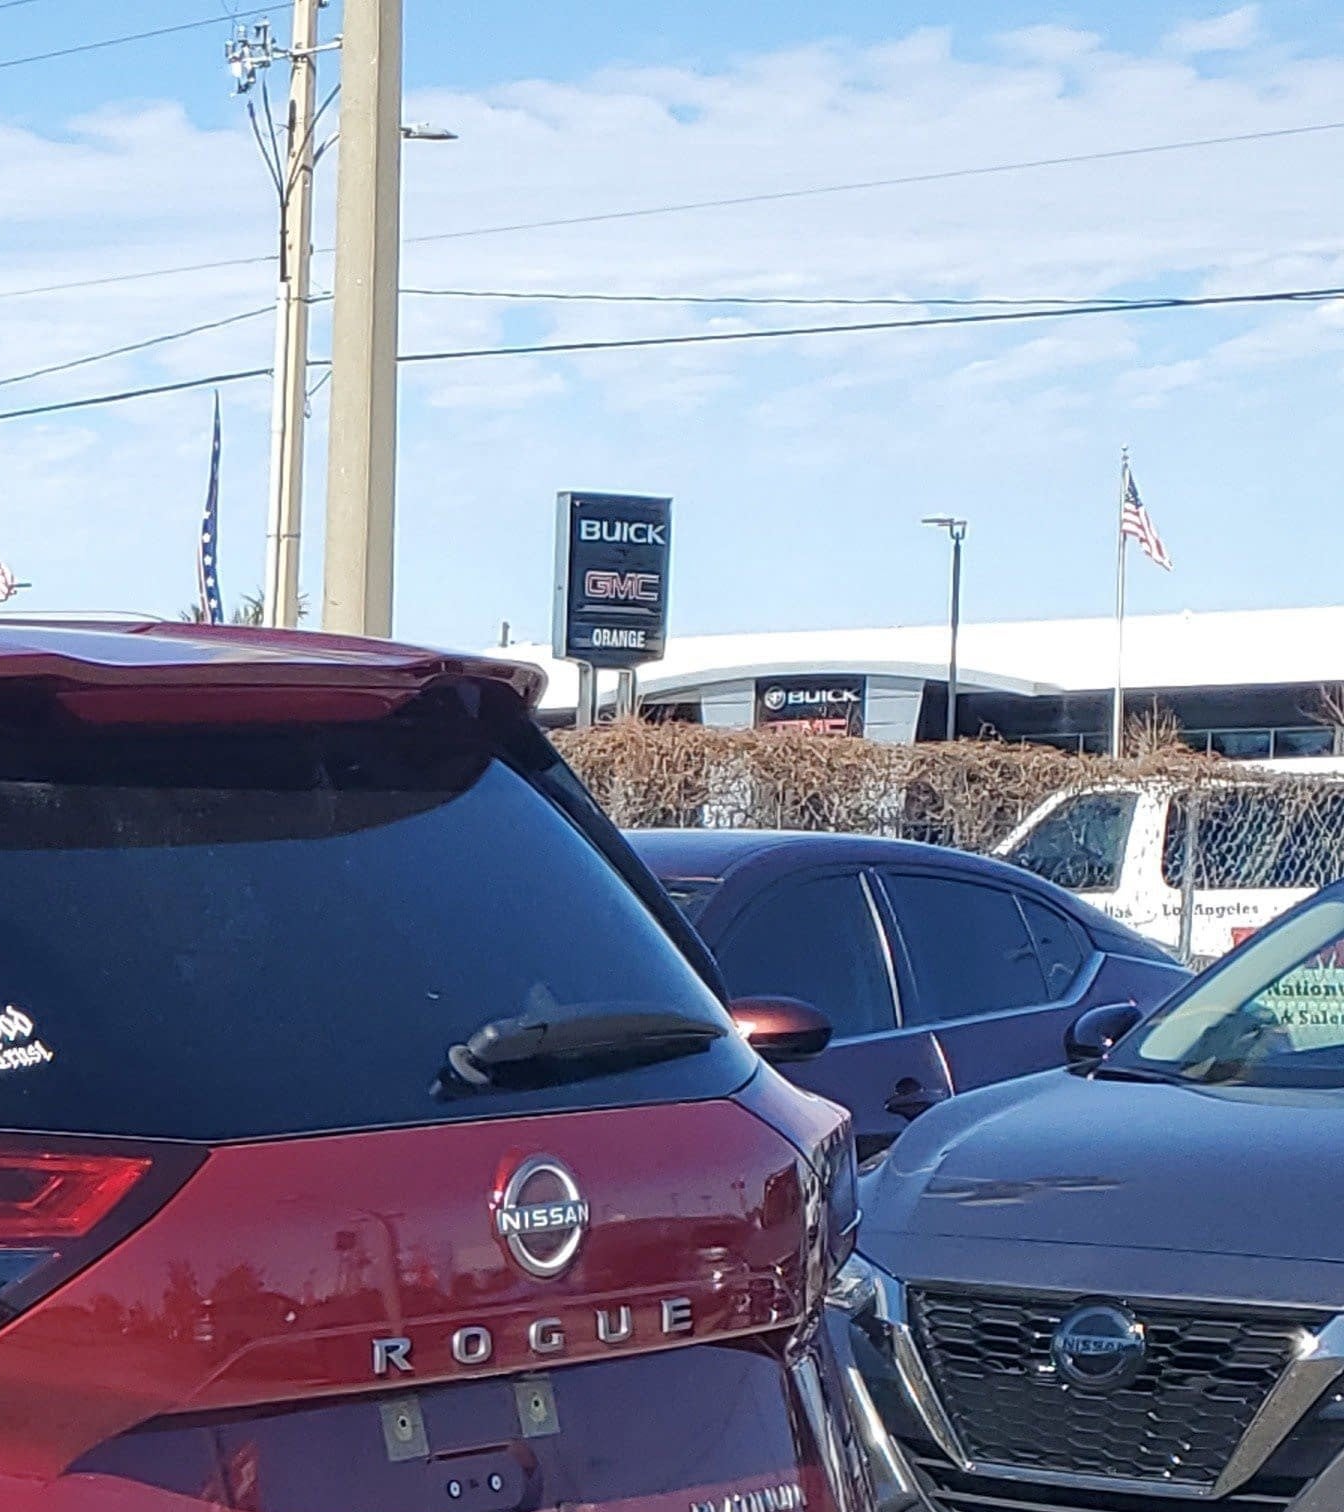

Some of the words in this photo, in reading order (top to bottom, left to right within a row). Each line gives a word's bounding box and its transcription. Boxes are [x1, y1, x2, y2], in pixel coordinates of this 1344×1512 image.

[579, 518, 667, 545] BUICK
[584, 570, 660, 602] GMC
[592, 627, 647, 649] ORANGE
[787, 688, 862, 705] BUICK
[1192, 902, 1260, 919] Angeles
[502, 1201, 590, 1233] NISSAN
[371, 1297, 693, 1374] ROGUE
[1062, 1335, 1135, 1353] NISSAN
